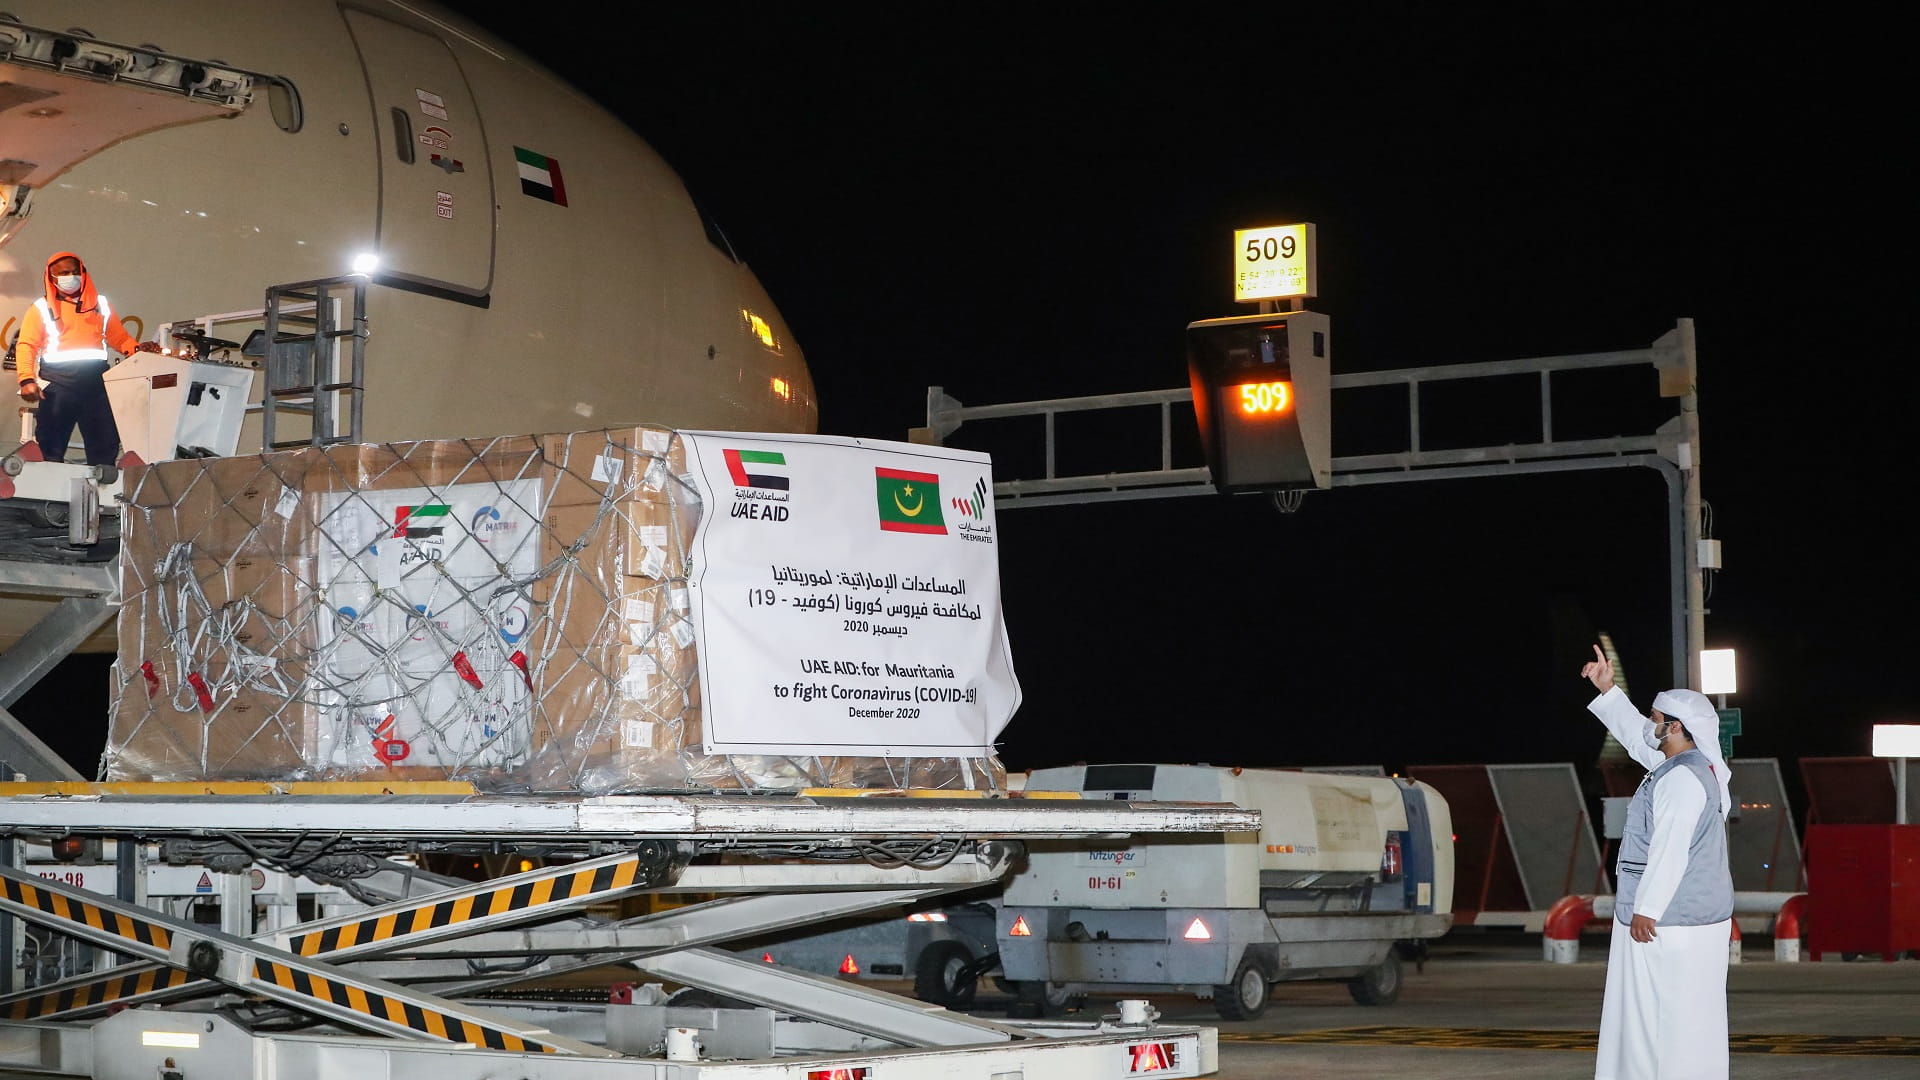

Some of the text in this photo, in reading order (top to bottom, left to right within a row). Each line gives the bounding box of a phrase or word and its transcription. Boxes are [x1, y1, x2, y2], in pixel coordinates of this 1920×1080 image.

[438, 207, 451, 217] EXIT
[1246, 235, 1296, 262] 509
[1240, 272, 1246, 281] E
[1242, 382, 1286, 413] 509
[731, 502, 789, 522] UAE AID
[485, 521, 517, 532] MATRIX
[960, 533, 993, 544] THE EMIRATES
[772, 565, 966, 595] المساعدات الإماراتية: لموريتانيا
[845, 595, 882, 616] كورونا
[887, 602, 928, 620] فيروس
[933, 603, 982, 620] لمكافحة
[843, 620, 908, 638] ديسمبر 2020
[800, 659, 831, 675] UAE
[885, 663, 955, 679] Mauritania
[774, 683, 977, 704] to fight Coronavirus (COVID-19)
[849, 707, 921, 719] December 2020
[1089, 877, 1121, 890] 01-61
